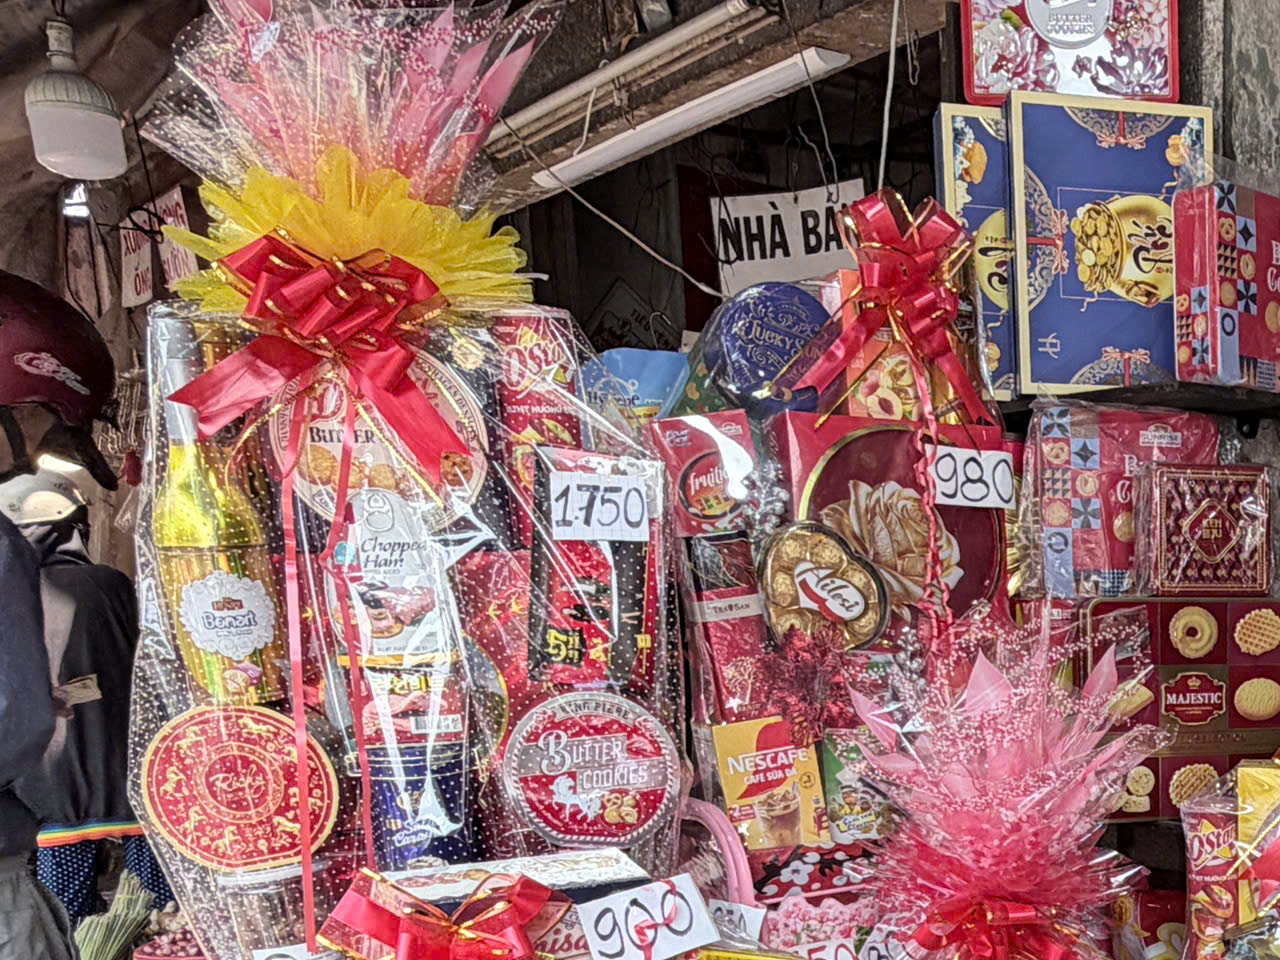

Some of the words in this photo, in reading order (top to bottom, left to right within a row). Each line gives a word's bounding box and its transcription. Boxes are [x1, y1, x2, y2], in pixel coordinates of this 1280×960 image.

[718, 202, 791, 263] NHÀ
[309, 426, 376, 445] BUTER
[935, 451, 1014, 504] 980
[553, 483, 646, 530] 1.750
[360, 538, 428, 560] Chopped
[1166, 691, 1222, 706] MAJESTIC
[538, 730, 623, 775] BUTTER
[582, 764, 649, 790] COOKIES
[593, 888, 694, 958] 900
[533, 931, 588, 958] nisa
